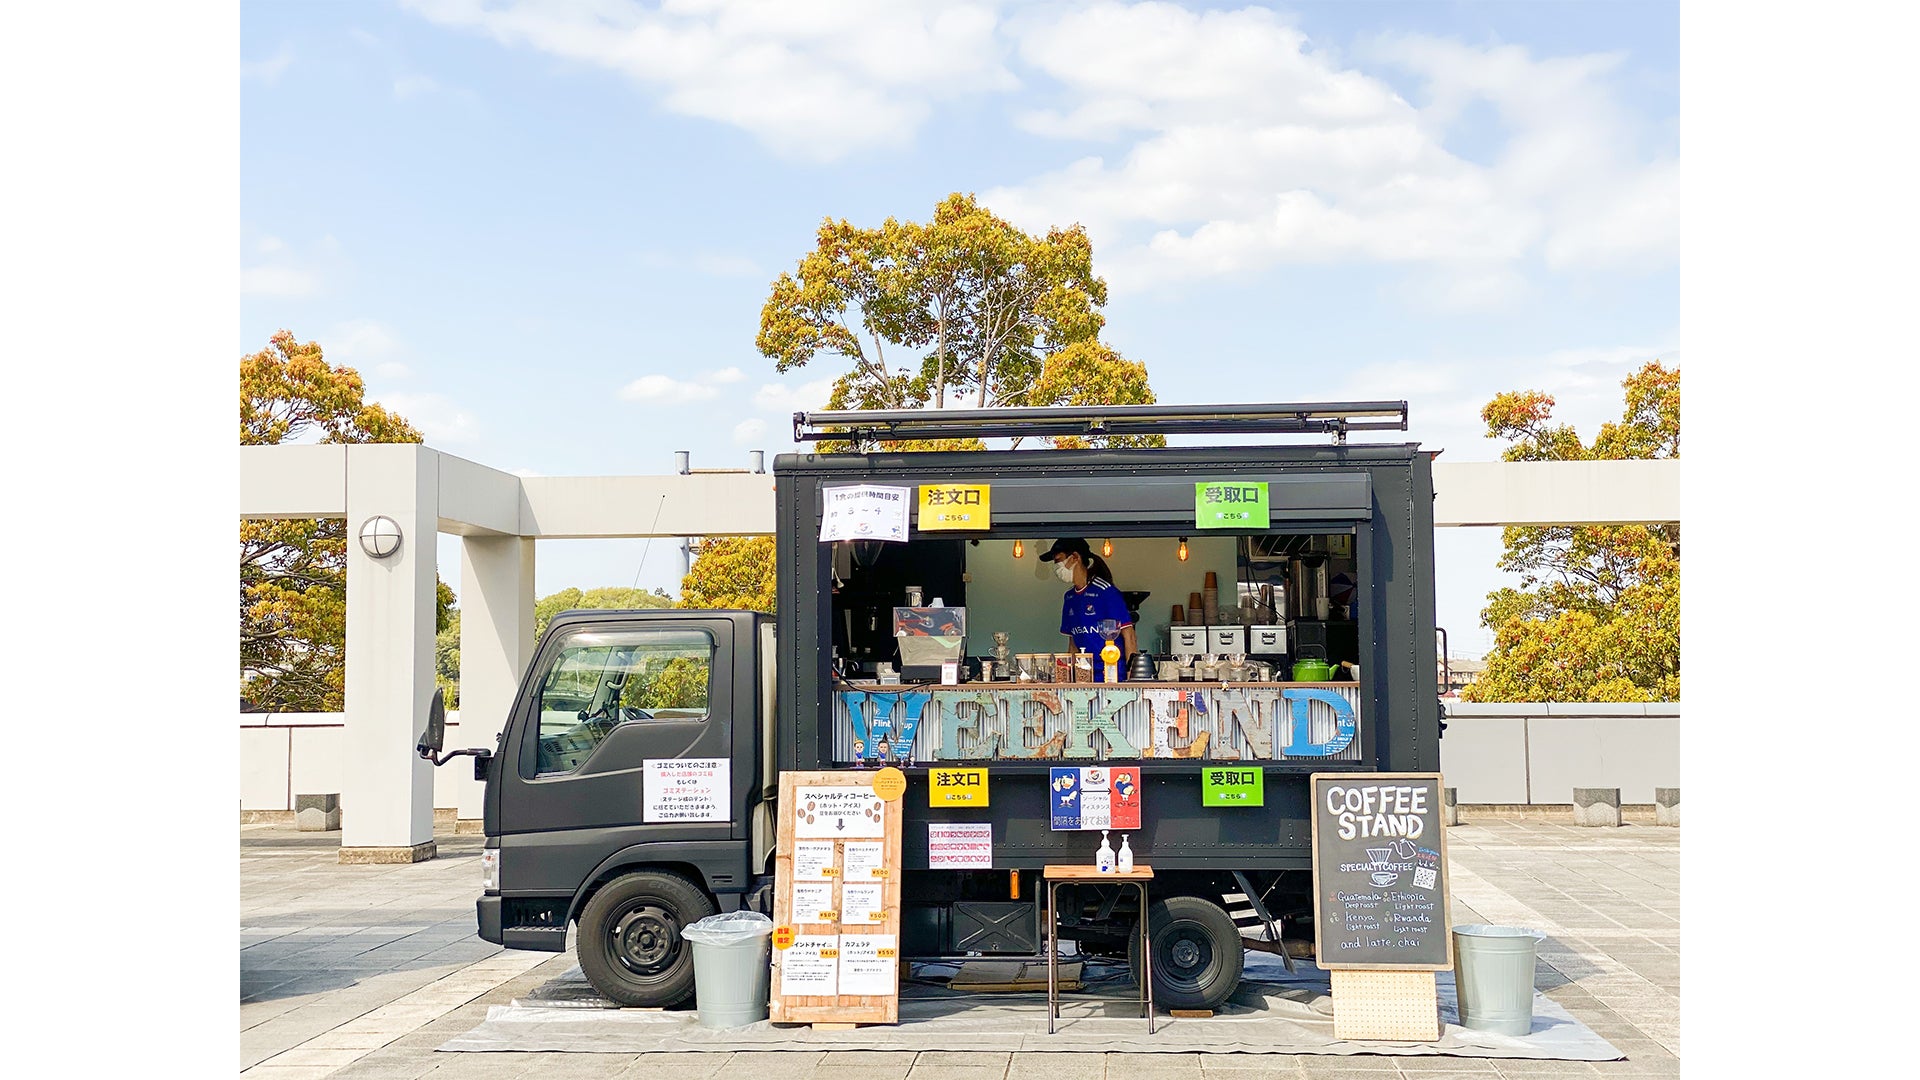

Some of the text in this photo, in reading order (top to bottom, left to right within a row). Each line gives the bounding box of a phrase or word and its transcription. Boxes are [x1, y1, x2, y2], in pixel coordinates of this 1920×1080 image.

[928, 488, 980, 506] 注文口
[1205, 486, 1259, 504] 受取口
[841, 689, 1356, 760] WEEKEND
[873, 719, 891, 728] Flint
[936, 772, 980, 786] 注文口
[1210, 771, 1255, 786] 受取口
[804, 792, 876, 800] スペシャルティコーヒー
[1327, 786, 1428, 815] COFFEE
[1337, 812, 1424, 840] STAND
[1337, 890, 1382, 902] Guatemala
[1390, 891, 1426, 902] Ethiopia
[1345, 911, 1375, 922] Kenya
[1393, 913, 1432, 923] Rwanda
[1341, 936, 1361, 949] and
[1398, 936, 1420, 948] chai
